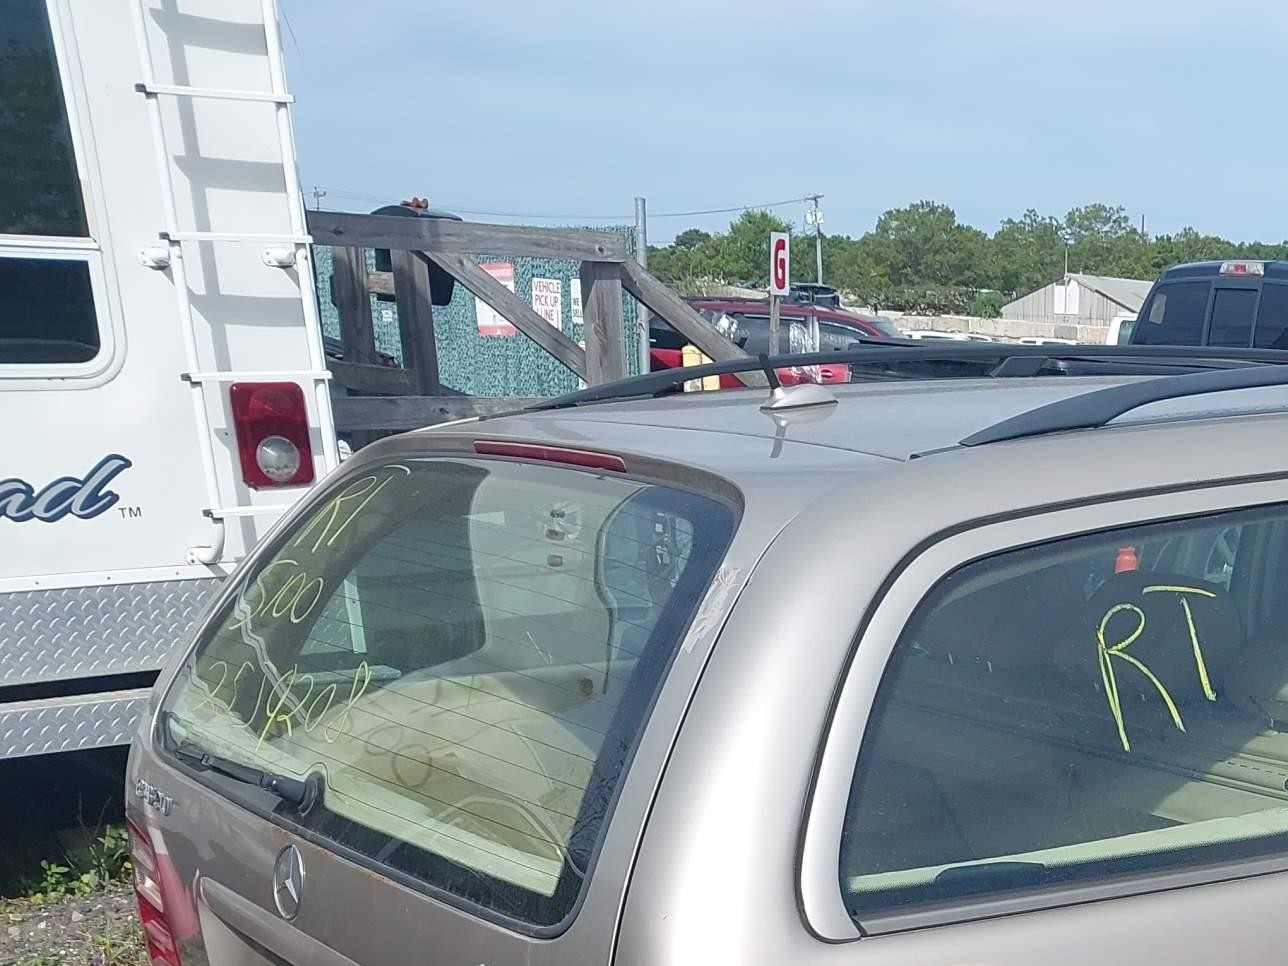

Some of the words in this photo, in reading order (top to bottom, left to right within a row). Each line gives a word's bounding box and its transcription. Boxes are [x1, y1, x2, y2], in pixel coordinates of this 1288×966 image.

[774, 239, 785, 289] G
[534, 280, 560, 293] VEHICLE
[535, 294, 549, 306] PICK
[550, 296, 558, 307] UP
[118, 507, 142, 519] TM
[1096, 585, 1217, 752] RT
